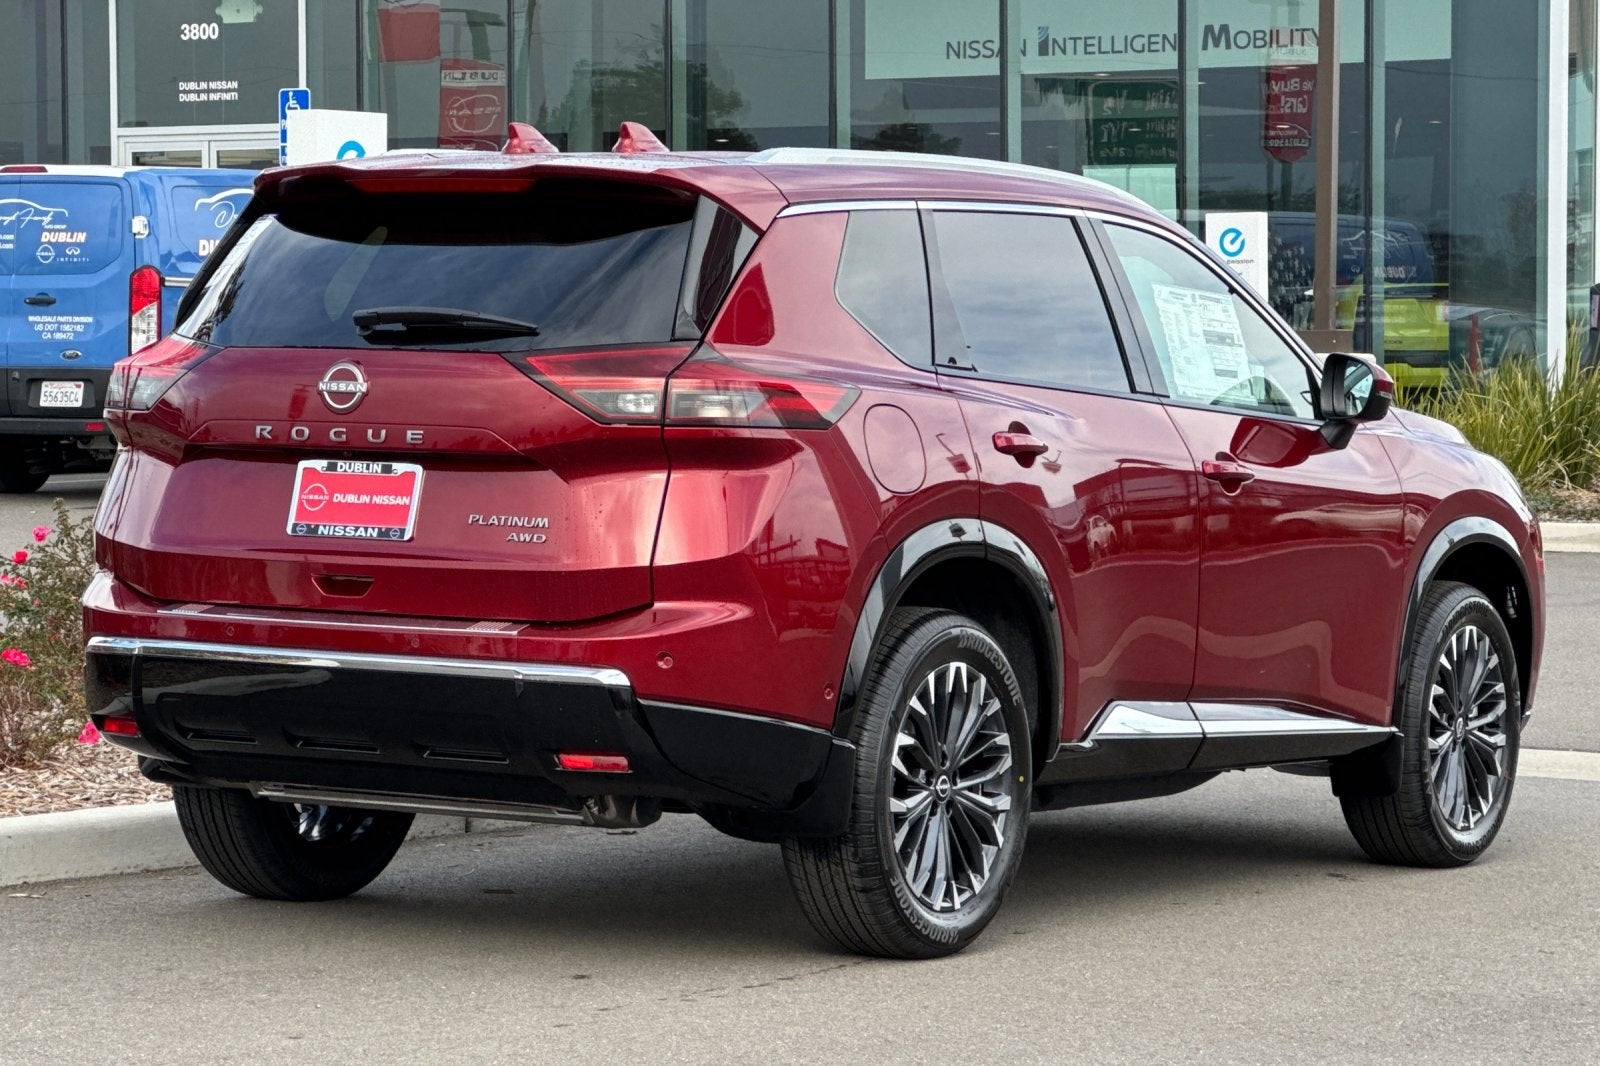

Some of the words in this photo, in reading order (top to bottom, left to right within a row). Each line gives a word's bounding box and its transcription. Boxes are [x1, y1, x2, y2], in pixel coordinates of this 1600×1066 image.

[180, 23, 219, 41] 3800
[1037, 26, 1177, 57] INTELLIGEN
[178, 82, 208, 91] DUBLIN
[209, 81, 239, 90] NISSAN
[178, 93, 208, 102] DUBLIN
[208, 92, 239, 101] INFINITI
[41, 232, 87, 243] DUBLIN
[319, 382, 367, 393] NISSAN
[43, 390, 79, 403] 55635C4
[255, 425, 425, 445] ROGUE
[336, 462, 382, 474] DUBLIN
[332, 494, 371, 504] DUBLIN
[372, 495, 410, 506] NISSAN
[468, 514, 550, 528] PLATINUM
[317, 525, 378, 538] NISSAN
[506, 532, 547, 544] AWD
[957, 629, 1022, 706] BRIDGESTONE
[890, 875, 960, 944] BRIDGESTONE
